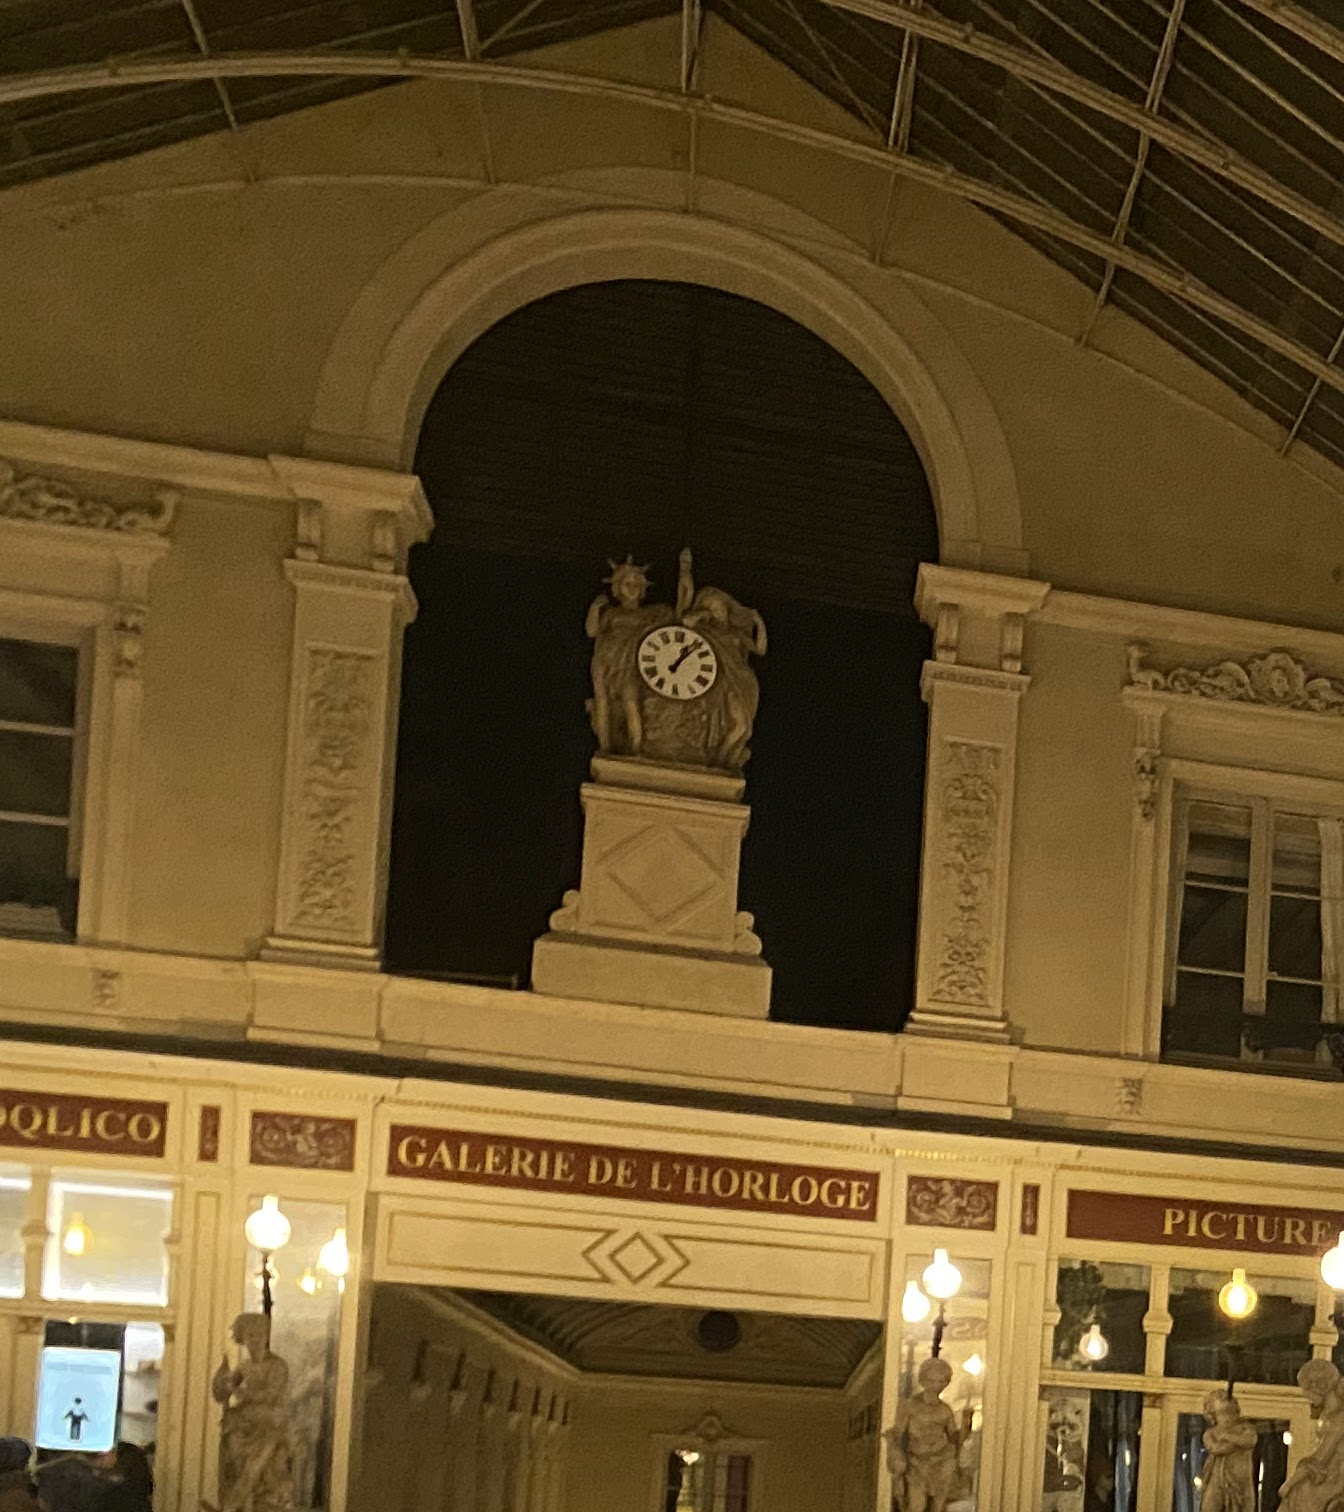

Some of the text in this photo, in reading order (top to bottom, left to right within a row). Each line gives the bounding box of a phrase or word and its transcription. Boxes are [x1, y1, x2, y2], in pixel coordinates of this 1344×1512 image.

[0, 1103, 162, 1143] QLICO
[398, 1135, 871, 1212] GALERIE DE L'HORLOGE
[1162, 1208, 1332, 1247] PICTURE
